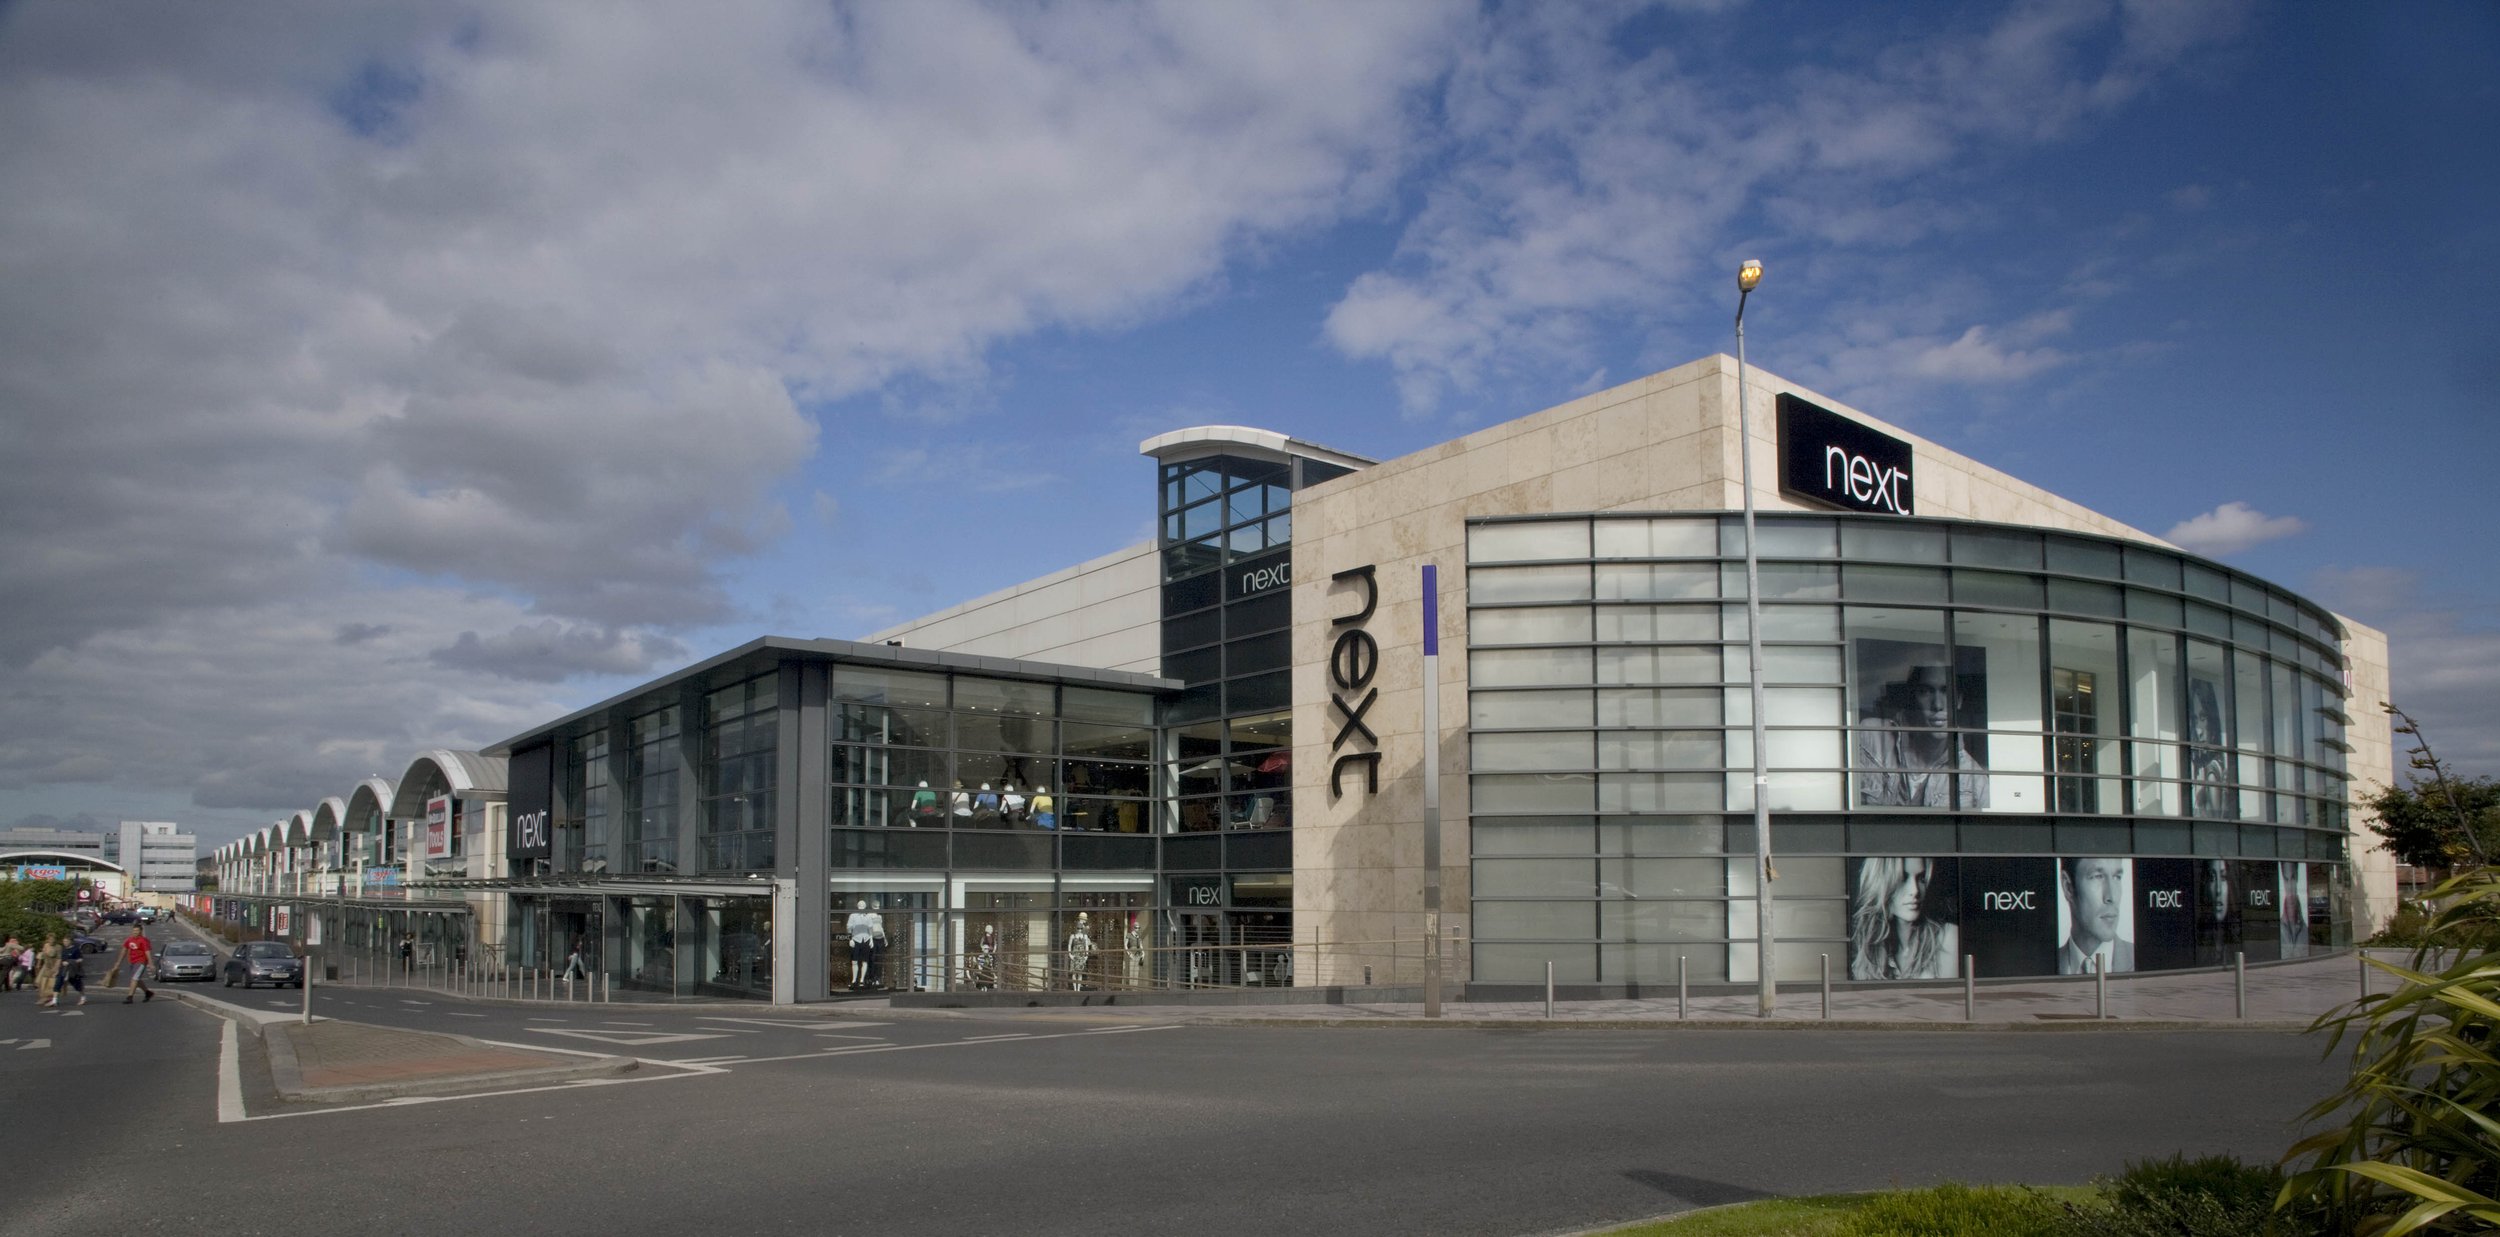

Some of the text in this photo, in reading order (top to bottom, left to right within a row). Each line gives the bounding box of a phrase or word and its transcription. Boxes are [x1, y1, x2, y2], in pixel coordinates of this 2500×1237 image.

[1826, 446, 1909, 516] next
[1243, 562, 1289, 593] next
[1331, 564, 1382, 798] next
[429, 831, 443, 848] TOOLS
[517, 809, 547, 848] next
[1984, 890, 2036, 910] next
[2149, 890, 2182, 907] next
[2250, 889, 2271, 906] next
